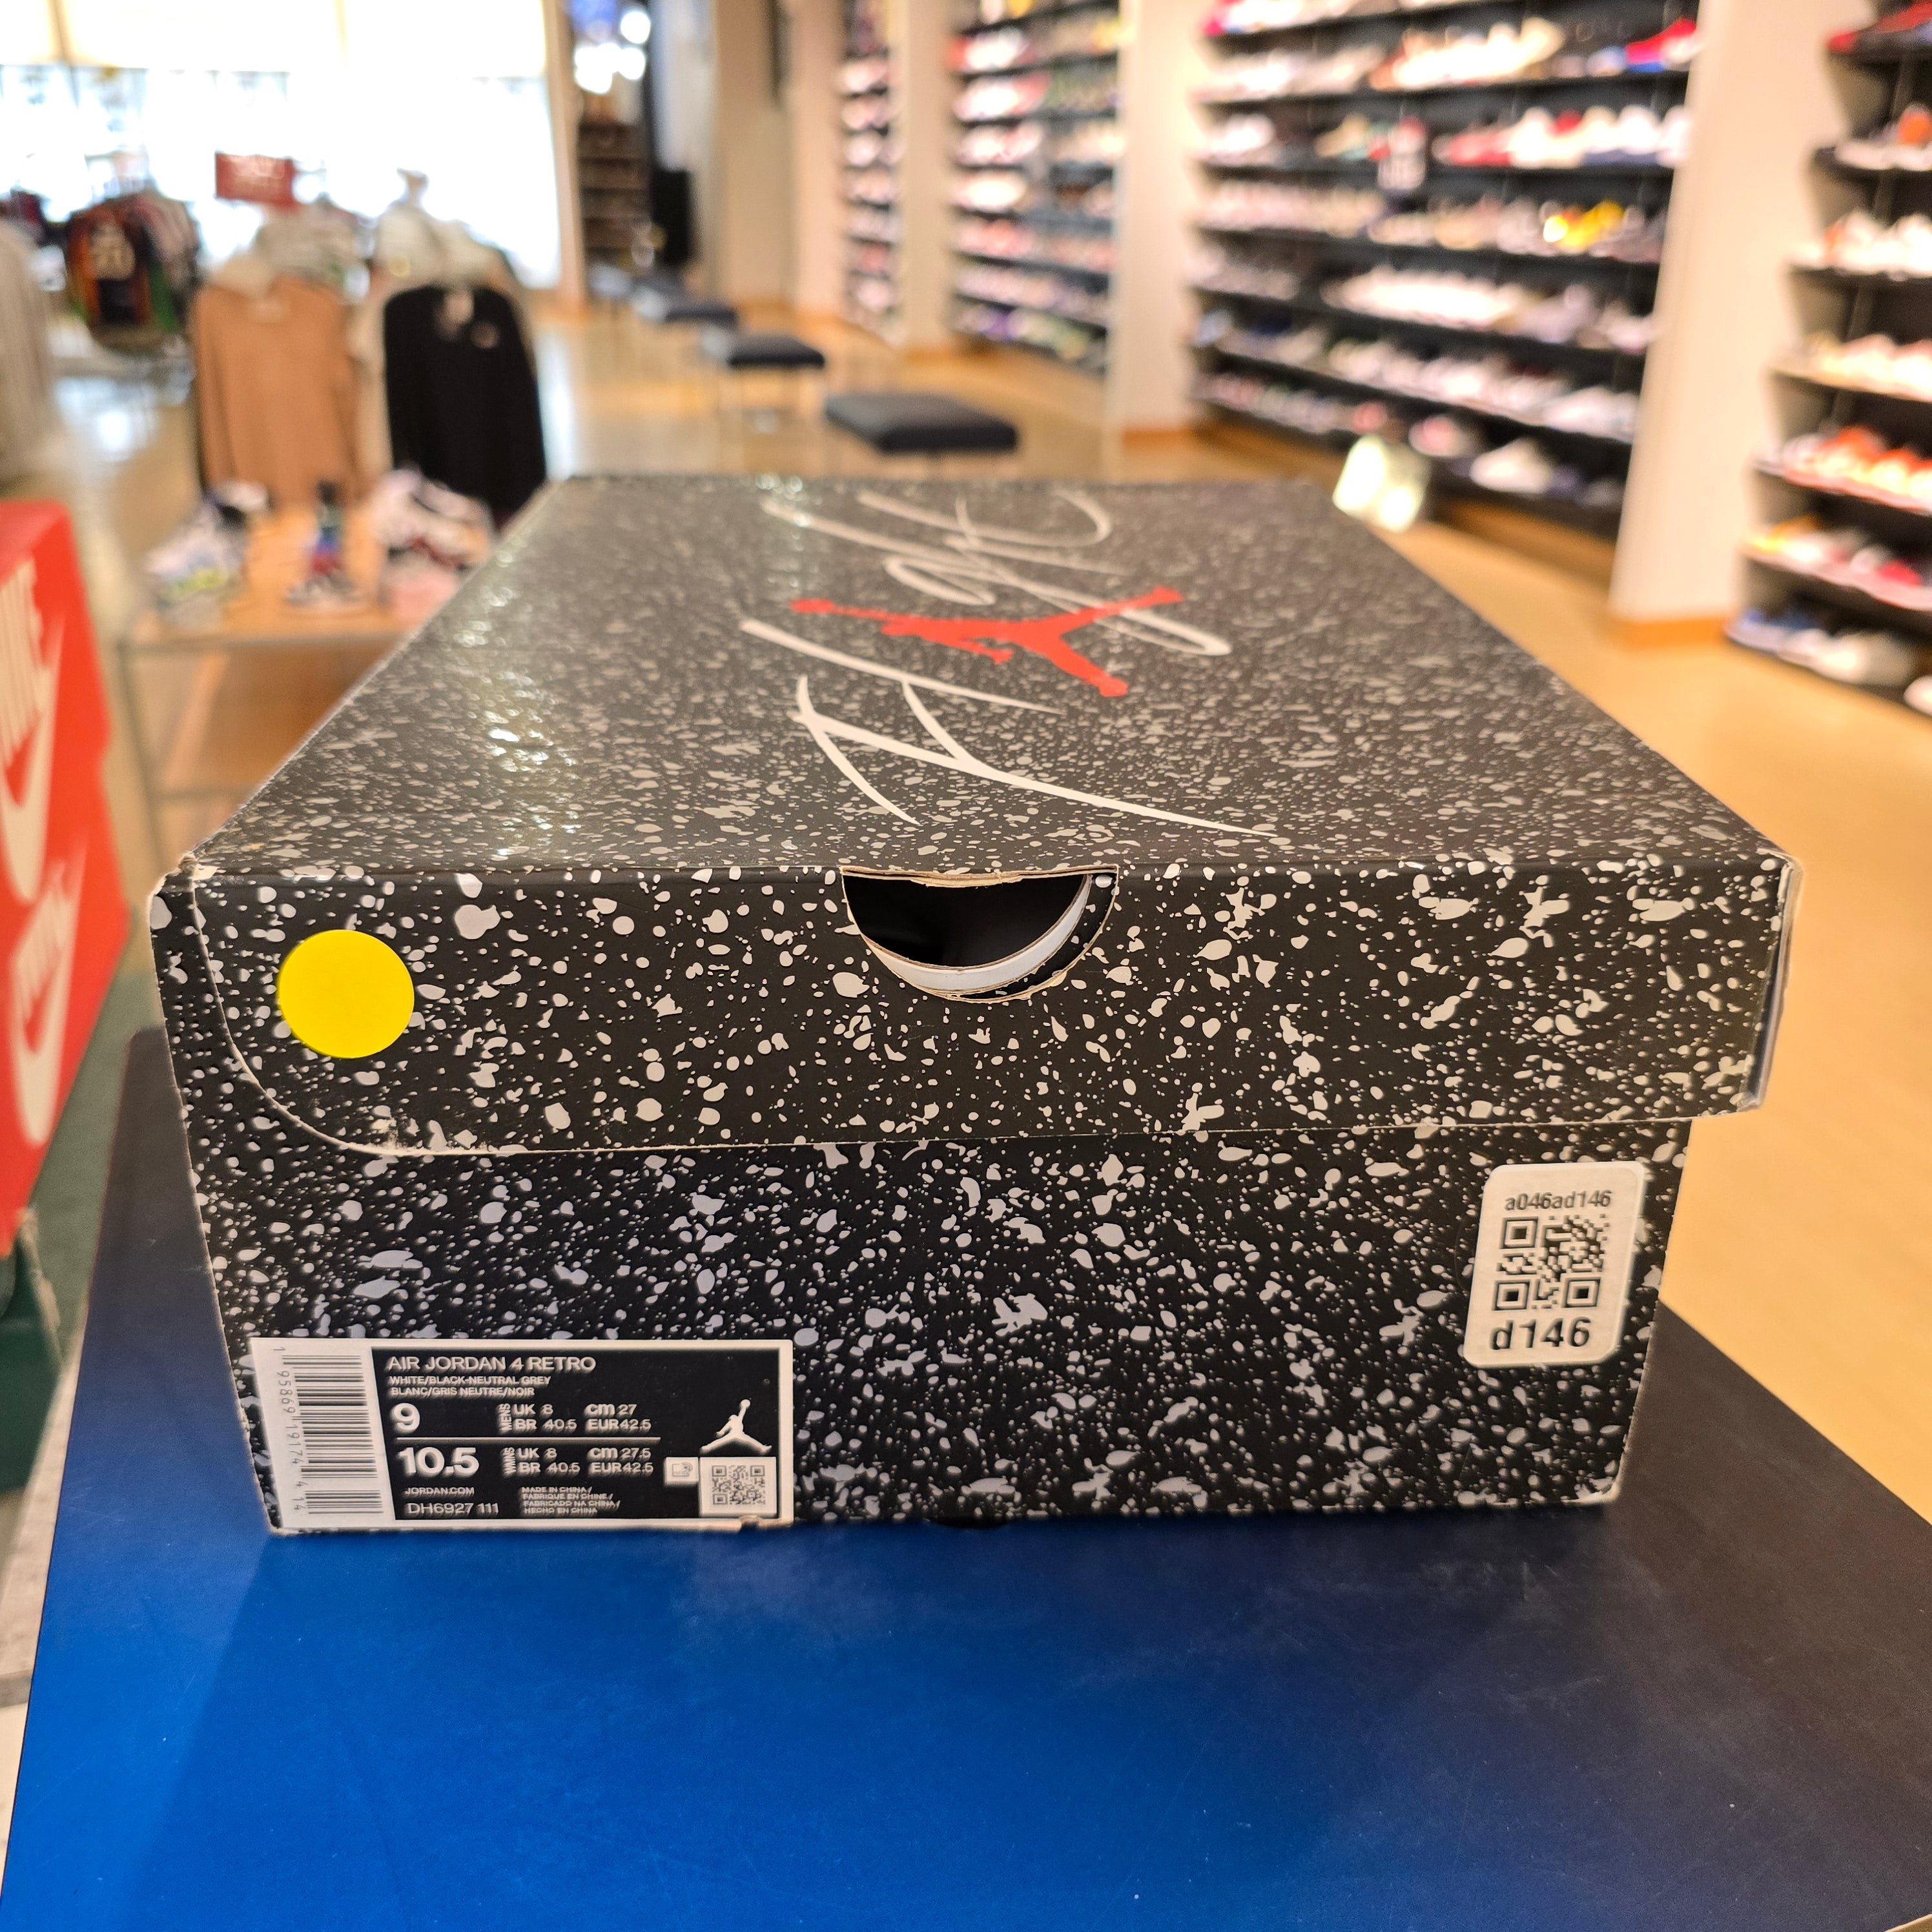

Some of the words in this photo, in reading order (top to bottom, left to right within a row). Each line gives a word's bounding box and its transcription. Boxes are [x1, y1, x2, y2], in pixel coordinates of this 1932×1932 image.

[739, 489, 1278, 837] Flght
[1504, 1189, 1612, 1211] a046ad146
[1489, 1316, 1592, 1351] d146
[387, 1356, 420, 1370] AIR
[425, 1356, 506, 1370] JORDAN
[510, 1357, 524, 1370] 4
[528, 1357, 596, 1370] RETRO
[389, 1375, 519, 1385] WHITE/BLACK-NEUTRAL
[521, 1375, 551, 1385] GREY
[391, 1387, 457, 1397] BLANC/GRIS
[460, 1387, 535, 1397] NEUTRE/NOIR
[513, 1404, 536, 1415] UK
[542, 1404, 553, 1415] 8
[617, 1404, 637, 1415] 27
[393, 1403, 420, 1433] 9
[499, 1403, 512, 1432] MENS
[515, 1419, 537, 1430] BR
[543, 1419, 577, 1430] 40.5
[518, 1448, 540, 1459] UK
[545, 1448, 557, 1459] 8
[620, 1448, 652, 1459] 27.5
[398, 1446, 480, 1475] 10.5
[502, 1447, 517, 1474] WMNS
[519, 1462, 541, 1473] BR
[548, 1462, 581, 1473] 40.5
[405, 1487, 475, 1495] JORDAN.COM
[407, 1503, 474, 1514] DH6927
[476, 1503, 498, 1514] 111
